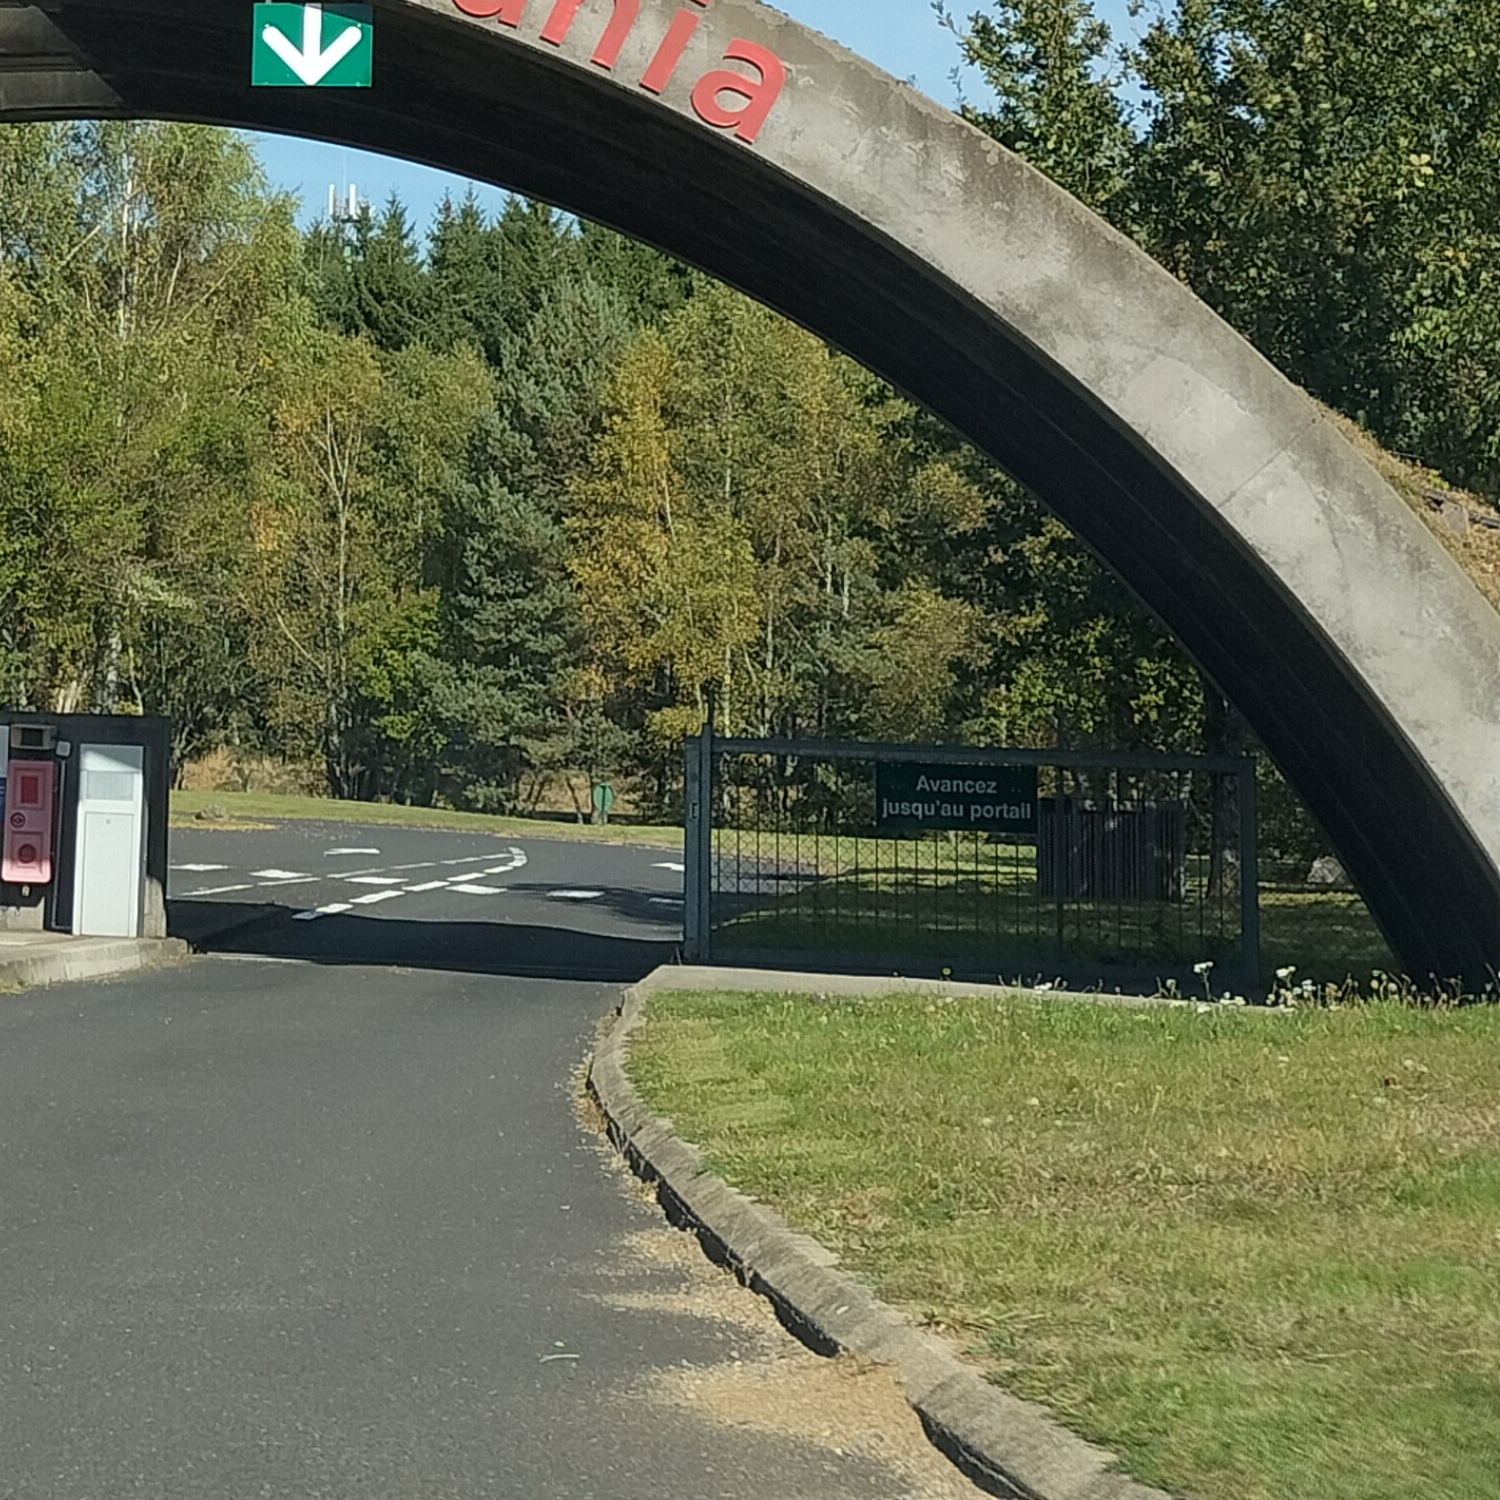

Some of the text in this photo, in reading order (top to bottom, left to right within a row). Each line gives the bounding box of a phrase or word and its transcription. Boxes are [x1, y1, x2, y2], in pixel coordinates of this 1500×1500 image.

[916, 774, 997, 794] Avancez
[882, 798, 1032, 822] jusqu'au portail
